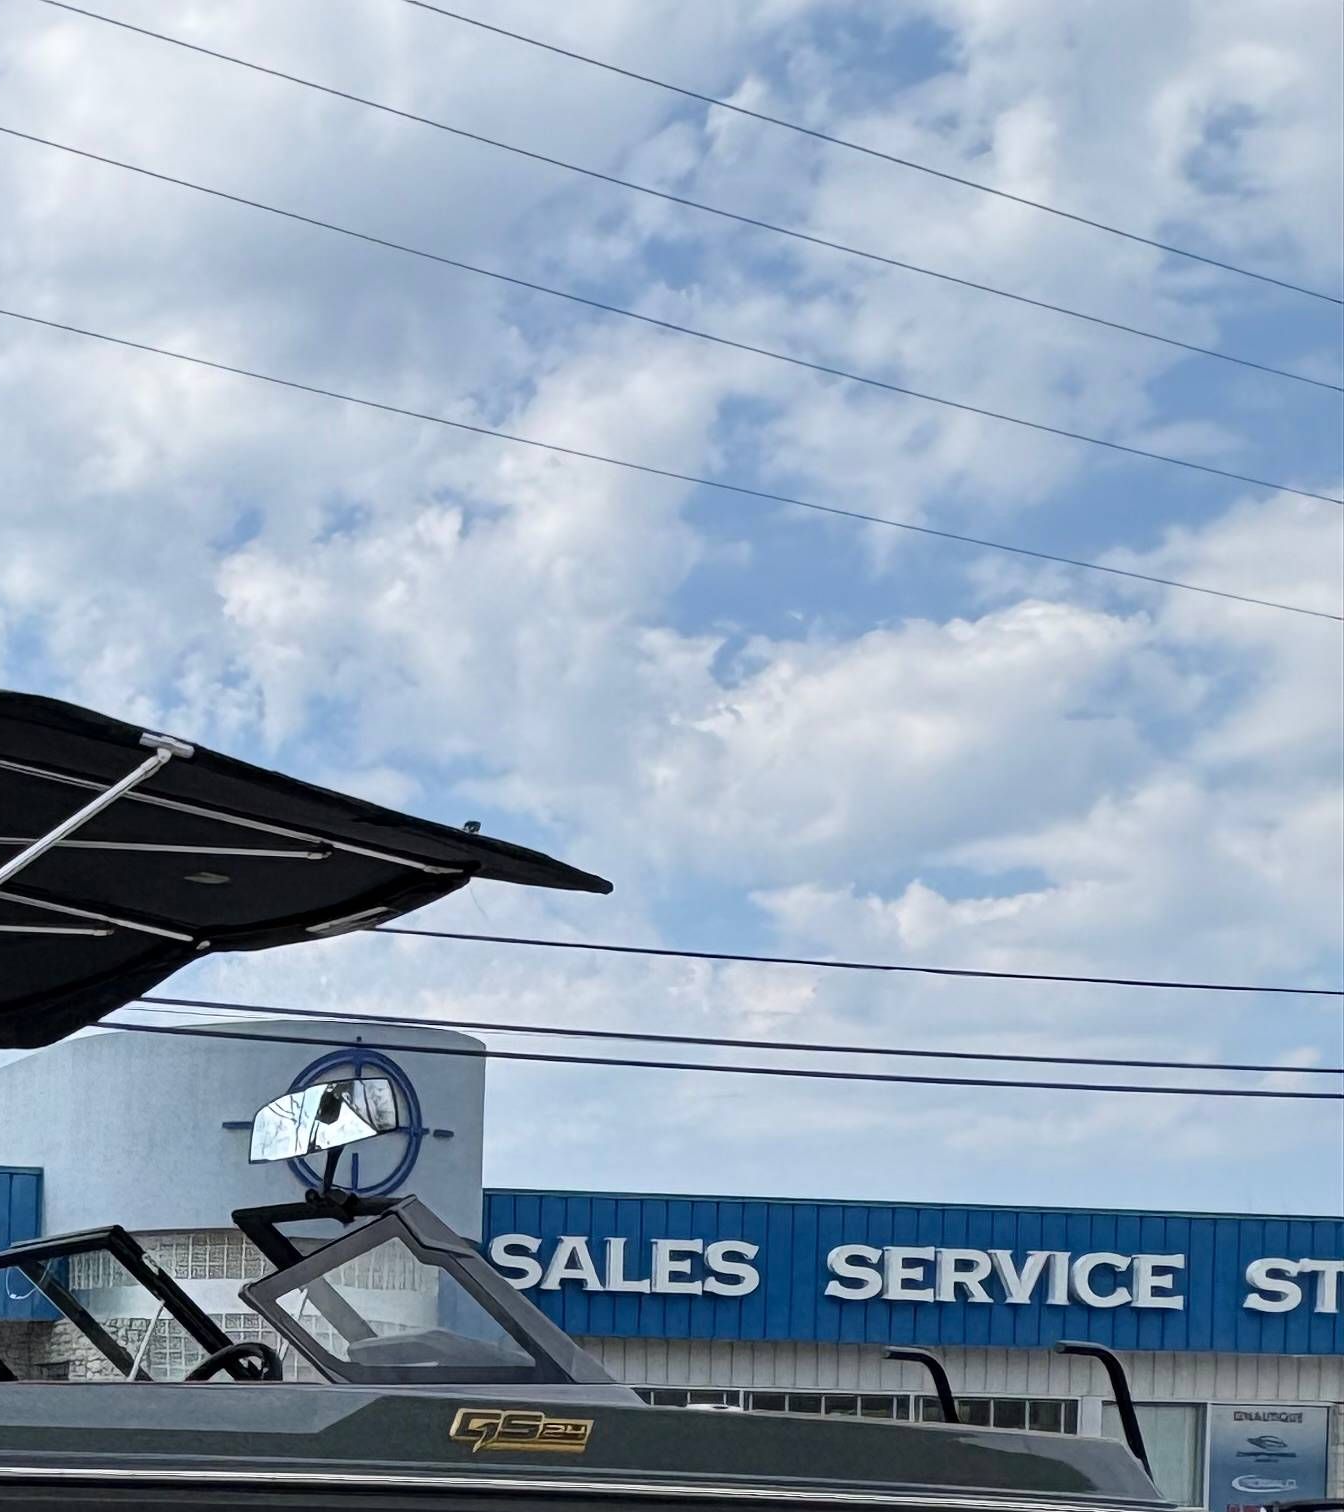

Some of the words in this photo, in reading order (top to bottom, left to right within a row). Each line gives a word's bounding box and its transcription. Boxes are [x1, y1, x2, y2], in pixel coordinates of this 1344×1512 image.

[488, 1233, 761, 1297] SALES
[824, 1243, 1185, 1311] SERVICE
[1242, 1256, 1344, 1314] ST
